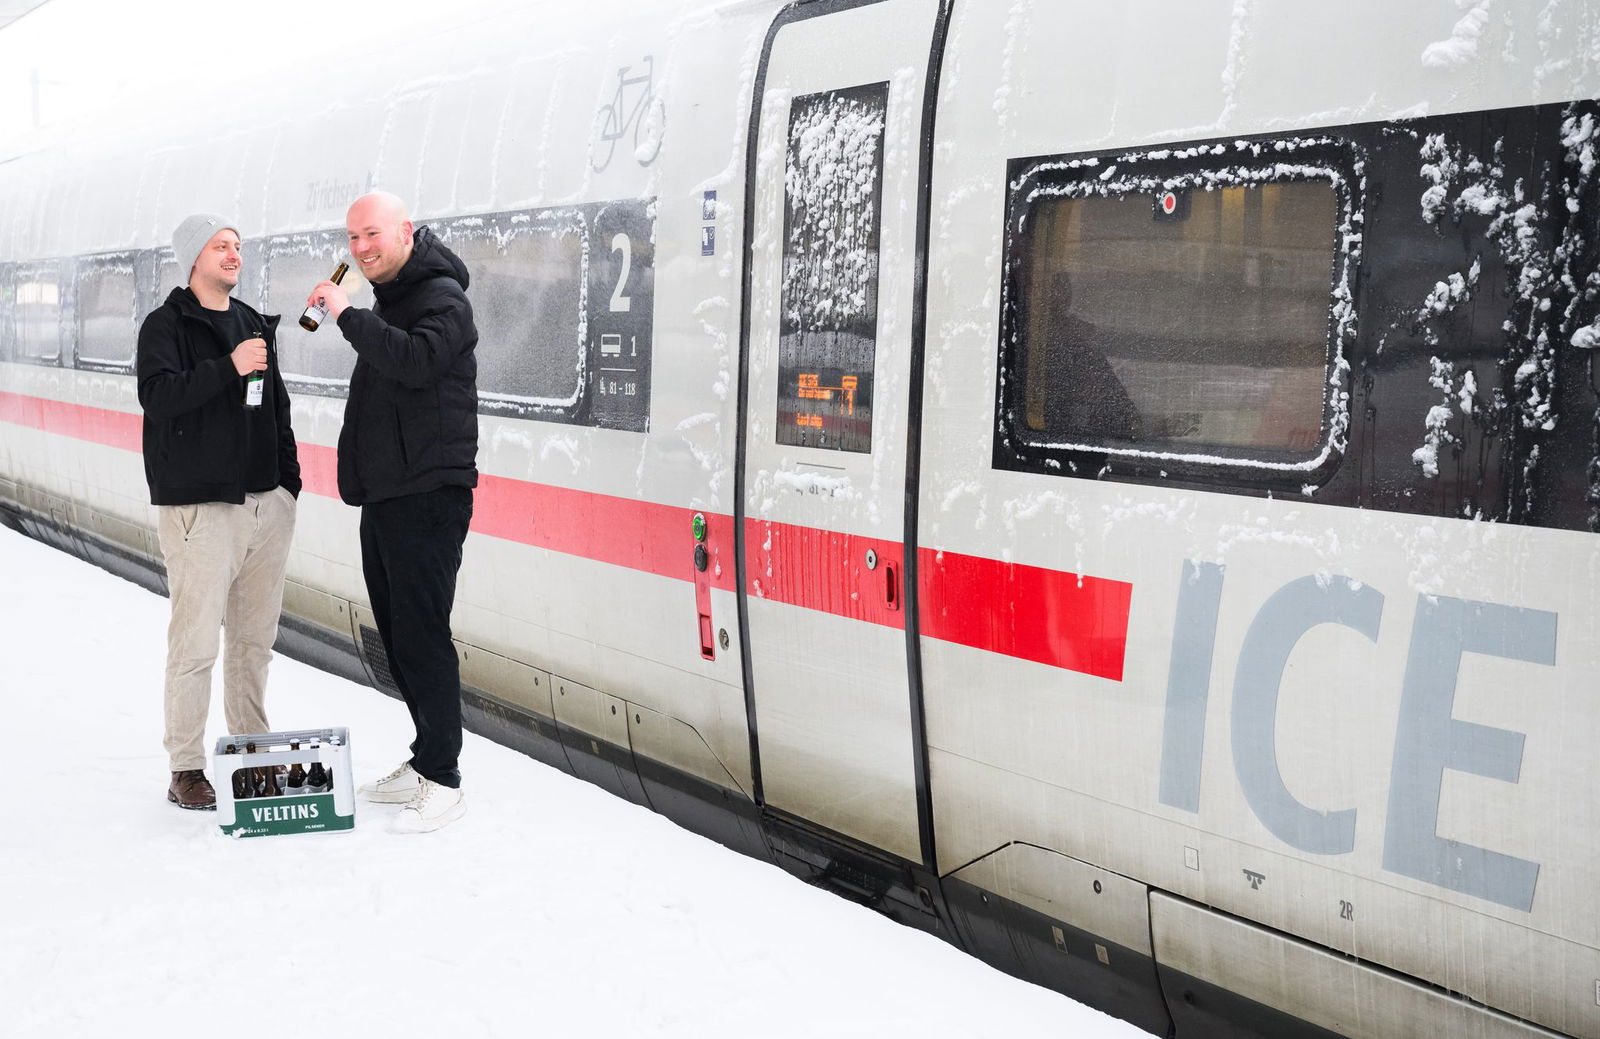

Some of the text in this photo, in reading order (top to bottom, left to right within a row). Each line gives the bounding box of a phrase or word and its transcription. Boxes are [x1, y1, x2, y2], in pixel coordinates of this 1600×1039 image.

[610, 233, 631, 312] 2
[631, 336, 637, 356] 1
[609, 381, 617, 395] 81
[625, 382, 636, 396] 118
[1158, 558, 1558, 913] ICE
[251, 803, 319, 823] VELTINS
[1339, 899, 1354, 921] 2R
